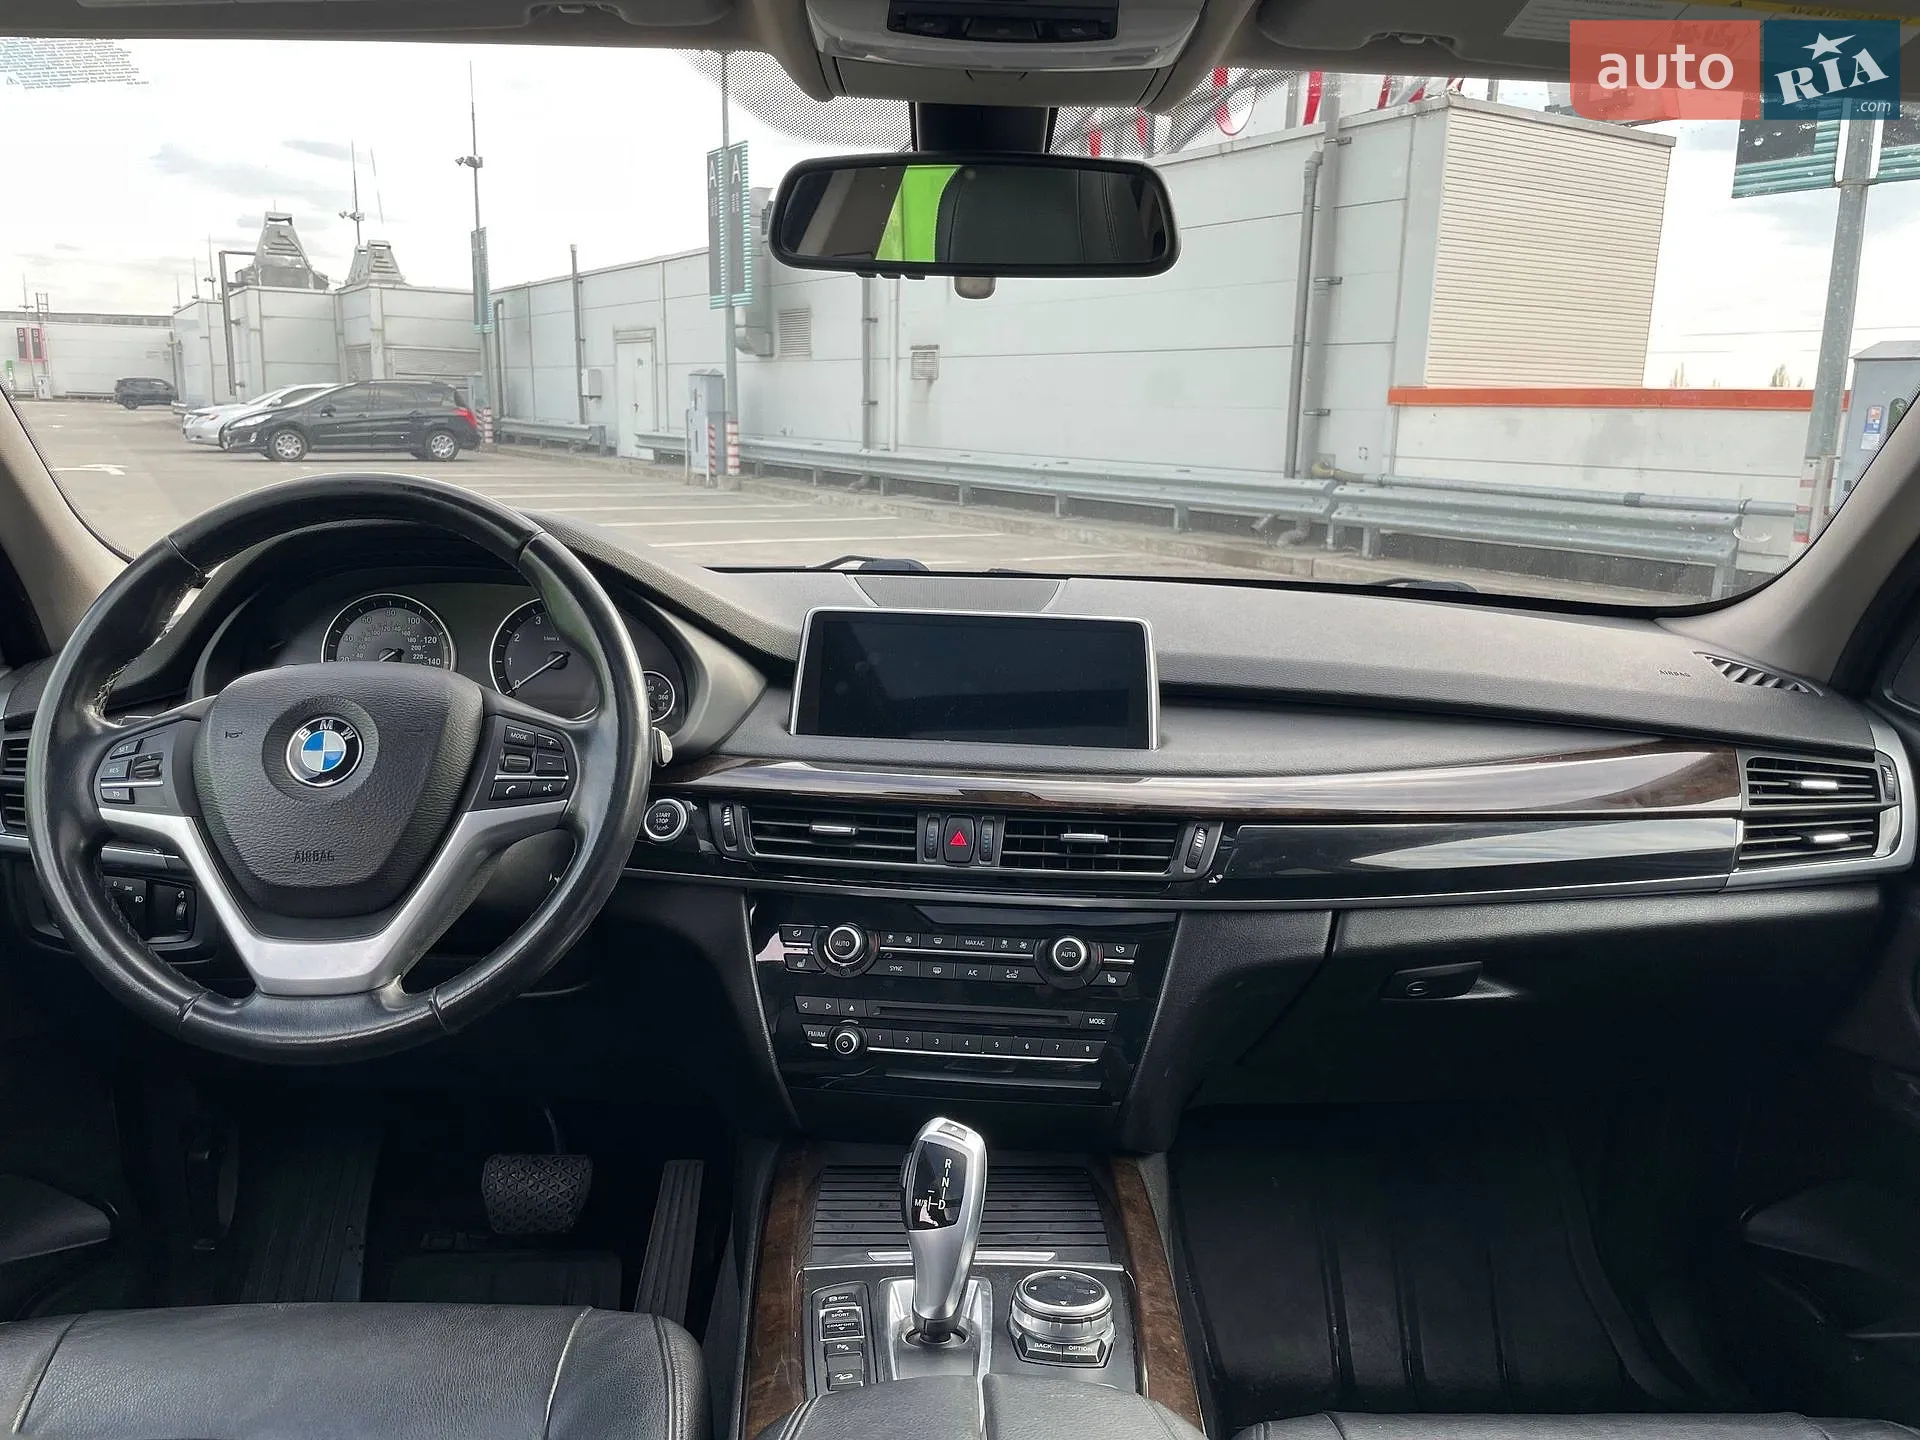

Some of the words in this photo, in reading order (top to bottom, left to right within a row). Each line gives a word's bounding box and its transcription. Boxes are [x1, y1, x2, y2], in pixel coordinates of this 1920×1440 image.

[731, 154, 741, 184] A
[709, 160, 717, 189] A
[535, 617, 541, 625] 3
[514, 633, 520, 642] 2
[508, 657, 512, 666] 1
[1658, 669, 1692, 678] AIRBAG
[297, 719, 356, 741] BMW
[510, 732, 528, 741] MODE
[293, 849, 335, 863] AIRBAG
[944, 1158, 952, 1169] R
[941, 1177, 950, 1187] N
[937, 1199, 946, 1210] D
[1068, 1345, 1093, 1353] OPTION
